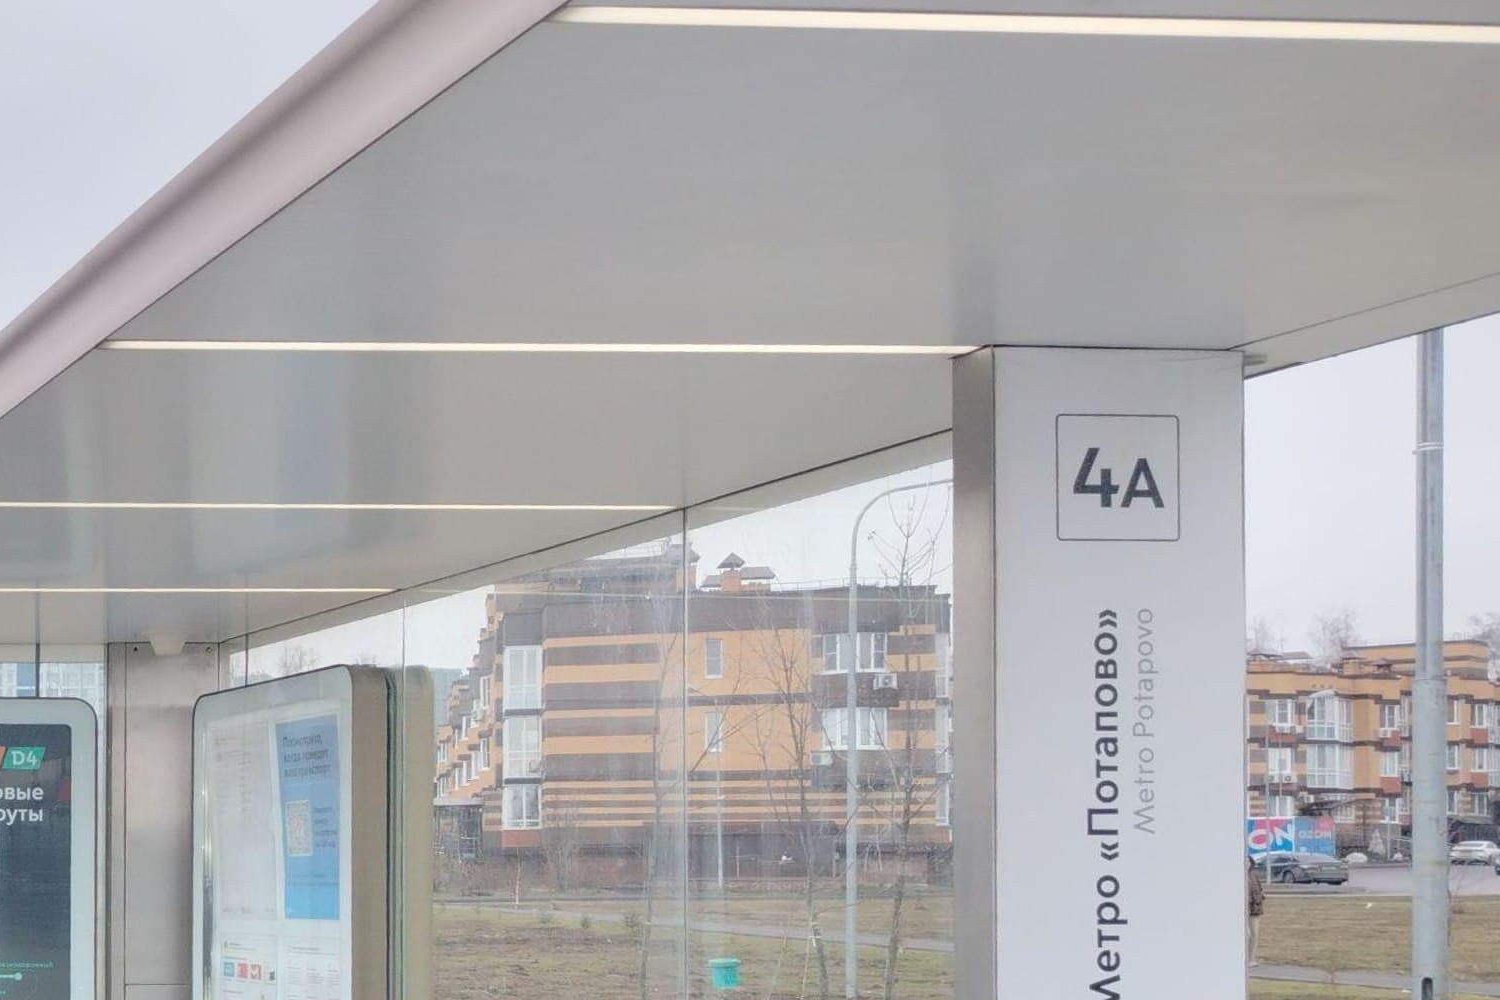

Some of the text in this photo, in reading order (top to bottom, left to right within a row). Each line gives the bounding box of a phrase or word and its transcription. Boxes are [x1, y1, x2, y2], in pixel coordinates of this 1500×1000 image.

[1073, 447, 1164, 508] 4А
[11, 751, 38, 766] D4
[1086, 608, 1119, 862] «Потапово»
[1133, 608, 1159, 834] Metro Potapovo
